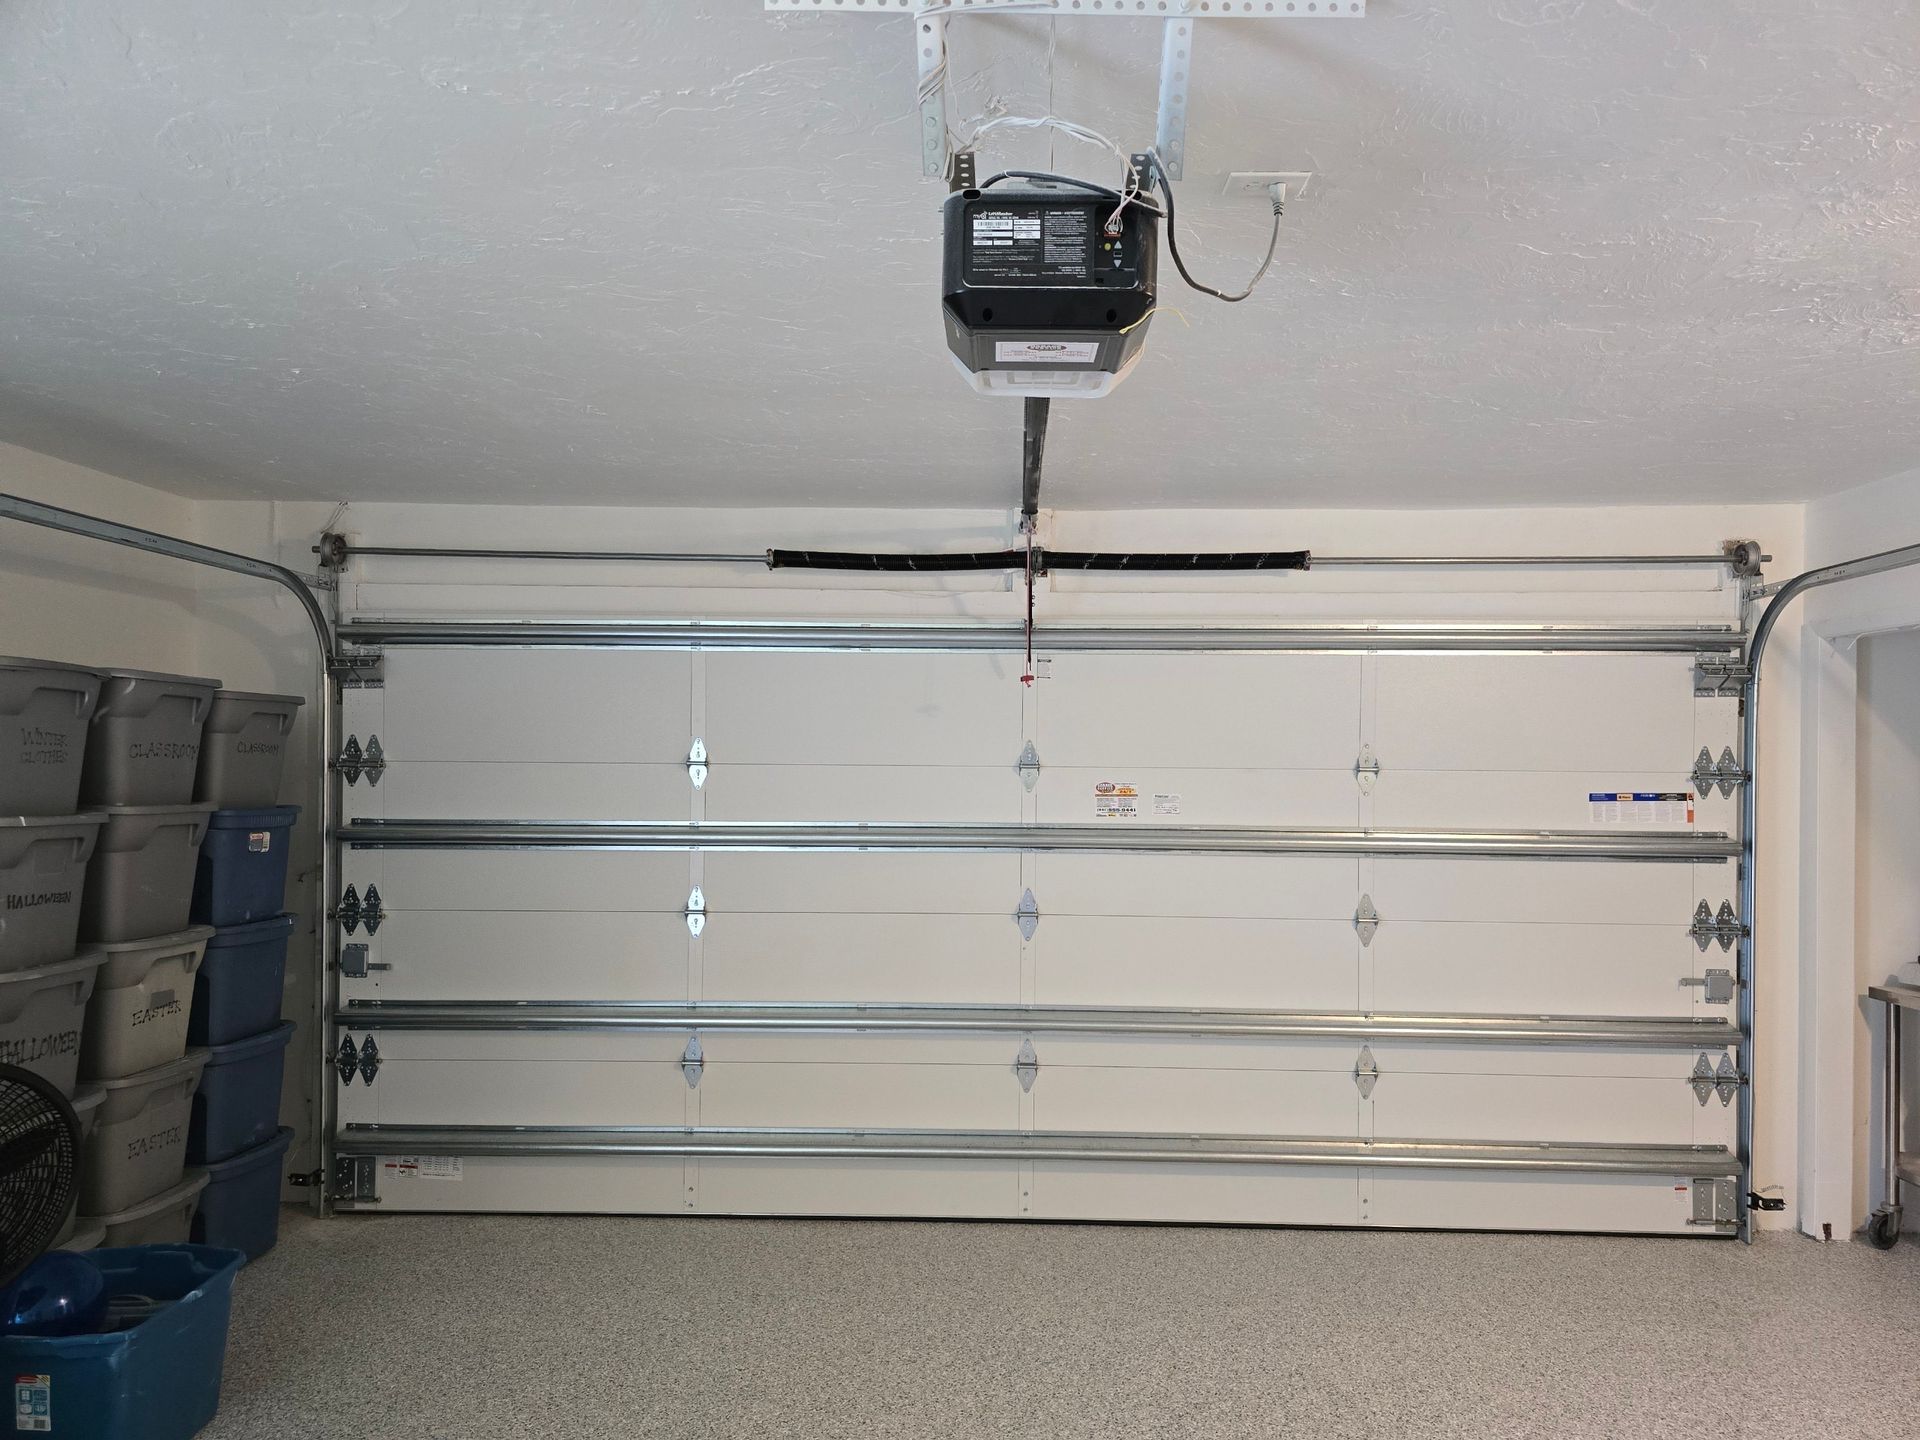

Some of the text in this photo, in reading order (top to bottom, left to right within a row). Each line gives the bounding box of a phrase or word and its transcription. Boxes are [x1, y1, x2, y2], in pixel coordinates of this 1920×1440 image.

[21, 727, 68, 748] WINTER
[20, 750, 69, 765] CLOTHES
[7, 891, 72, 910] HALLOWEEN
[132, 1000, 182, 1027] EASTER
[128, 1127, 181, 1159] EASTER
